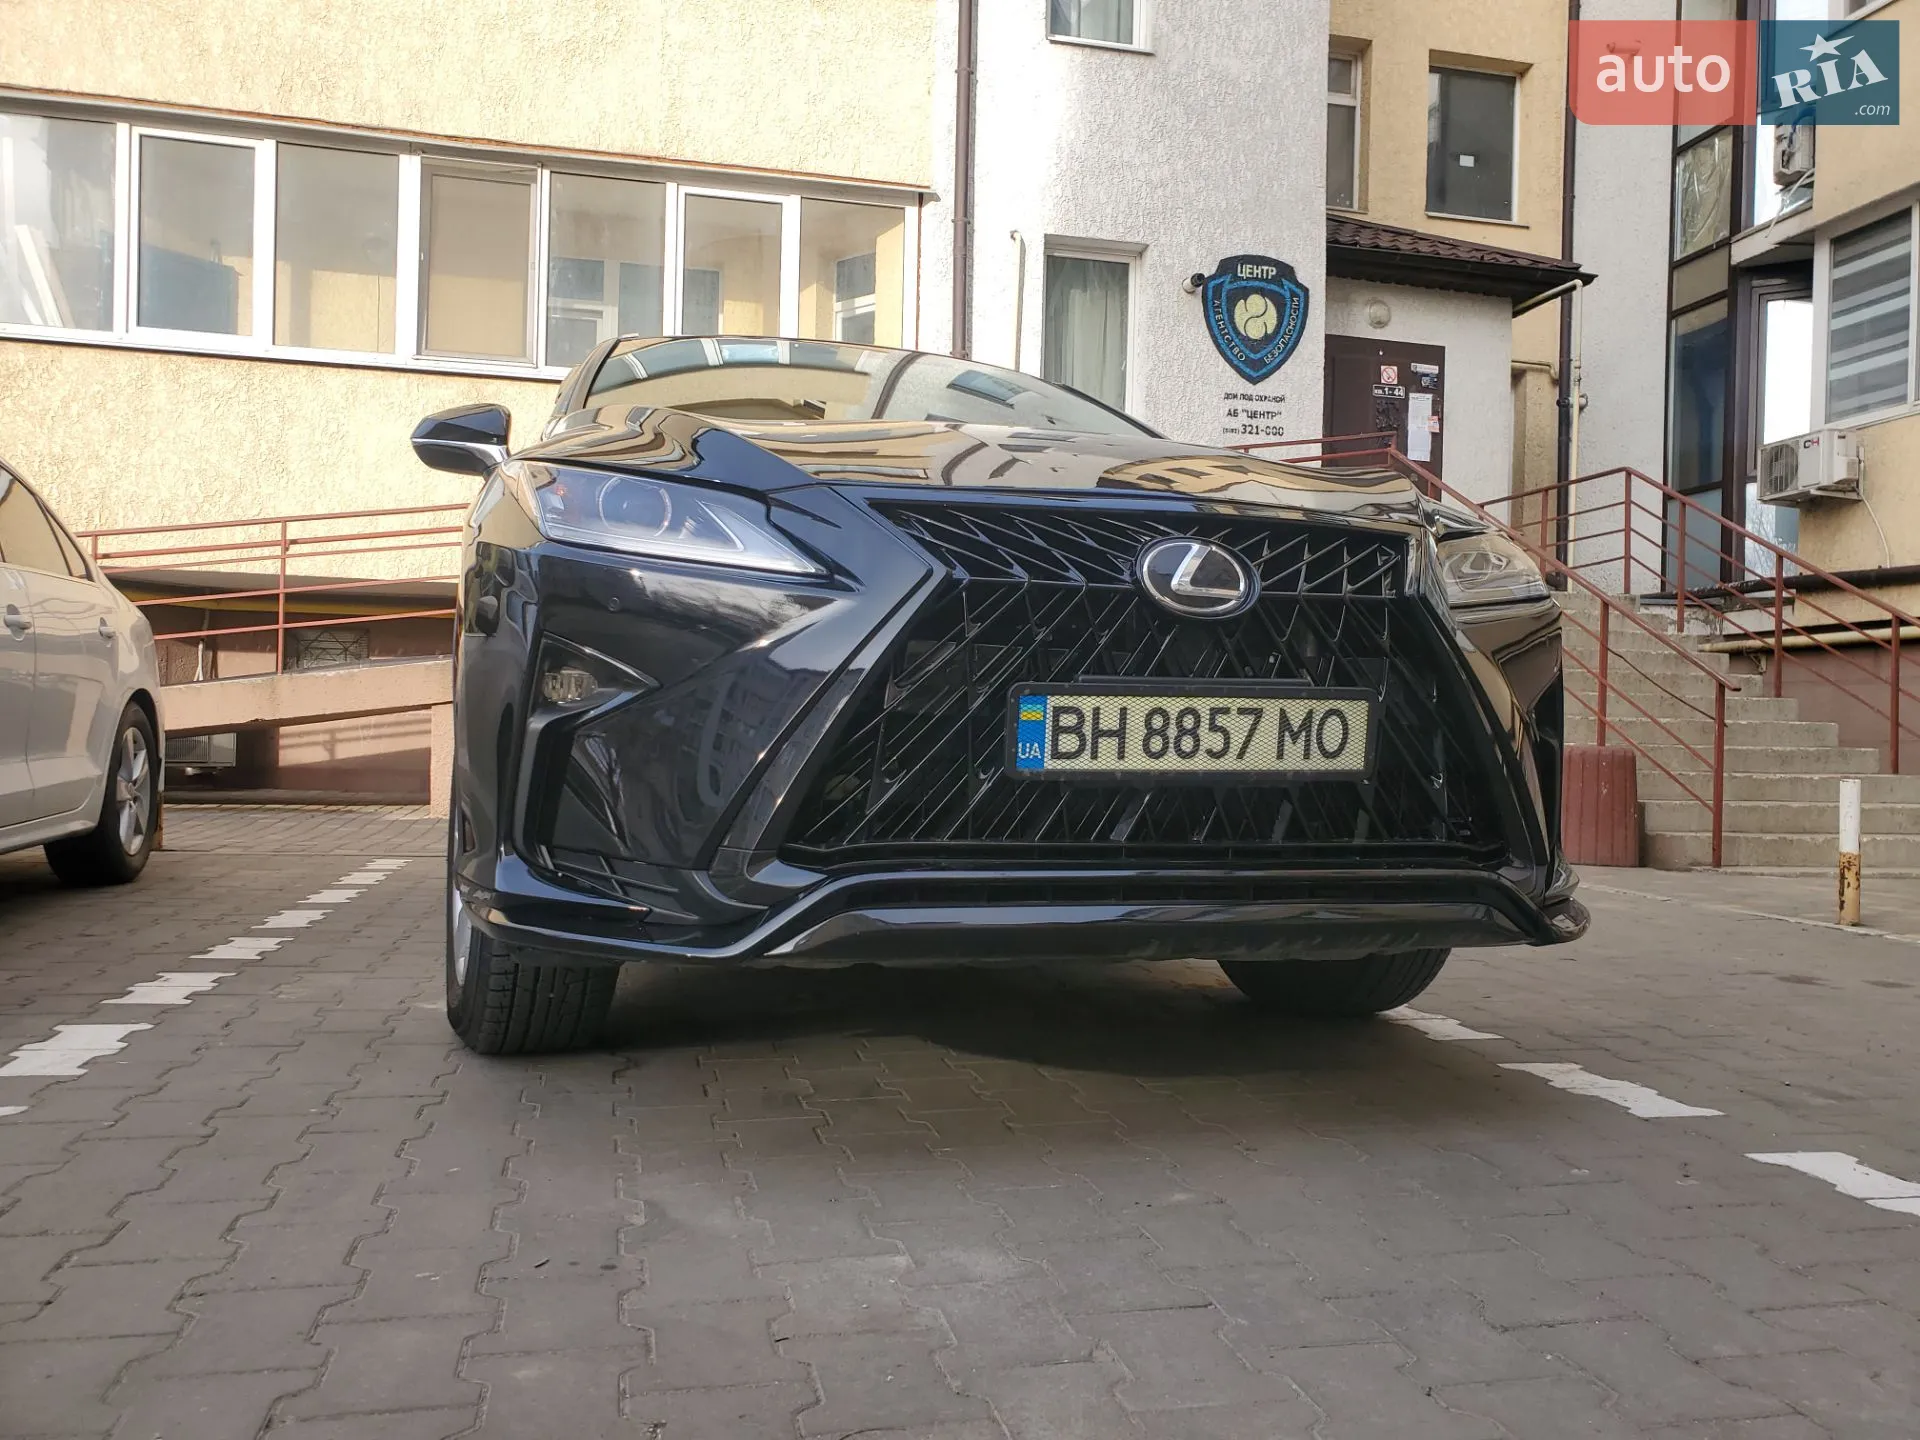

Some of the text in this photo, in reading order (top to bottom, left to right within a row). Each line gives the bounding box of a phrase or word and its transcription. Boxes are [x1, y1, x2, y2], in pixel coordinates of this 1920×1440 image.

[1236, 263, 1277, 280] ЦЕНТР
[1213, 300, 1246, 361] АГЕНТСТВО
[1263, 297, 1300, 364] БЕЗОПАСНОСТИ
[1223, 392, 1238, 401] ДОМ
[1239, 393, 1254, 402] ПОД
[1226, 408, 1282, 420] АБ "ЦЕНТР"
[1049, 705, 1349, 762] BH 8857 MO
[1017, 742, 1042, 760] UA
